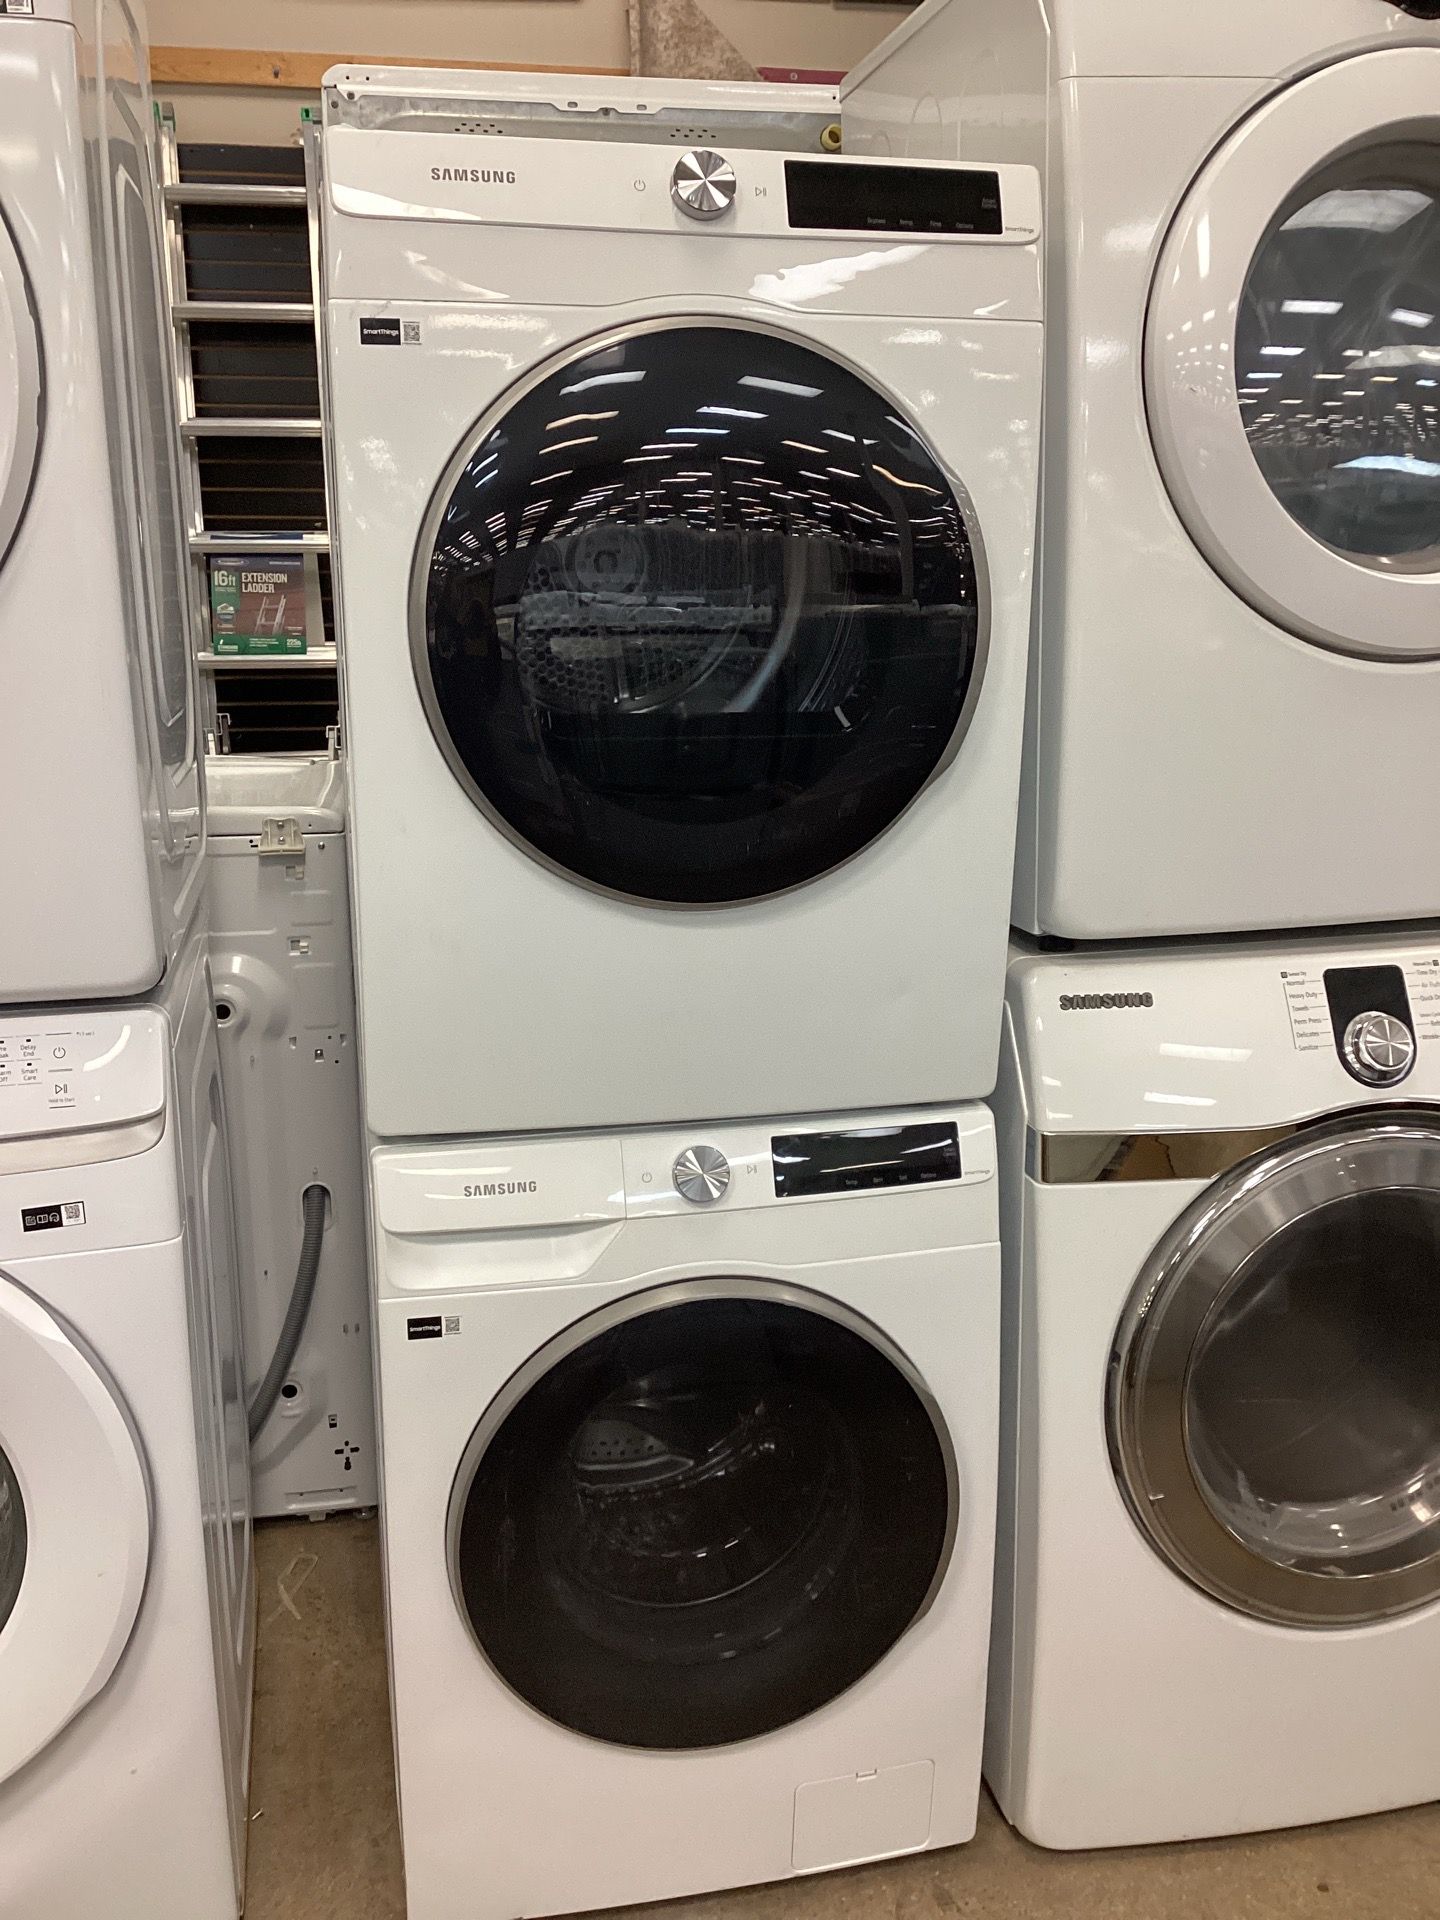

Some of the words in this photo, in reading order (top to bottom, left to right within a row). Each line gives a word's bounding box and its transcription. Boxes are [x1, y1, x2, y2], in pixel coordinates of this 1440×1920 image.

[431, 167, 516, 184] SAMSUNG
[363, 328, 399, 337] SmartThings
[241, 572, 288, 583] EXTENSION
[242, 583, 275, 593] LADDER
[1060, 992, 1153, 1011] SAMSUNG
[463, 1180, 537, 1197] SAMSUNG
